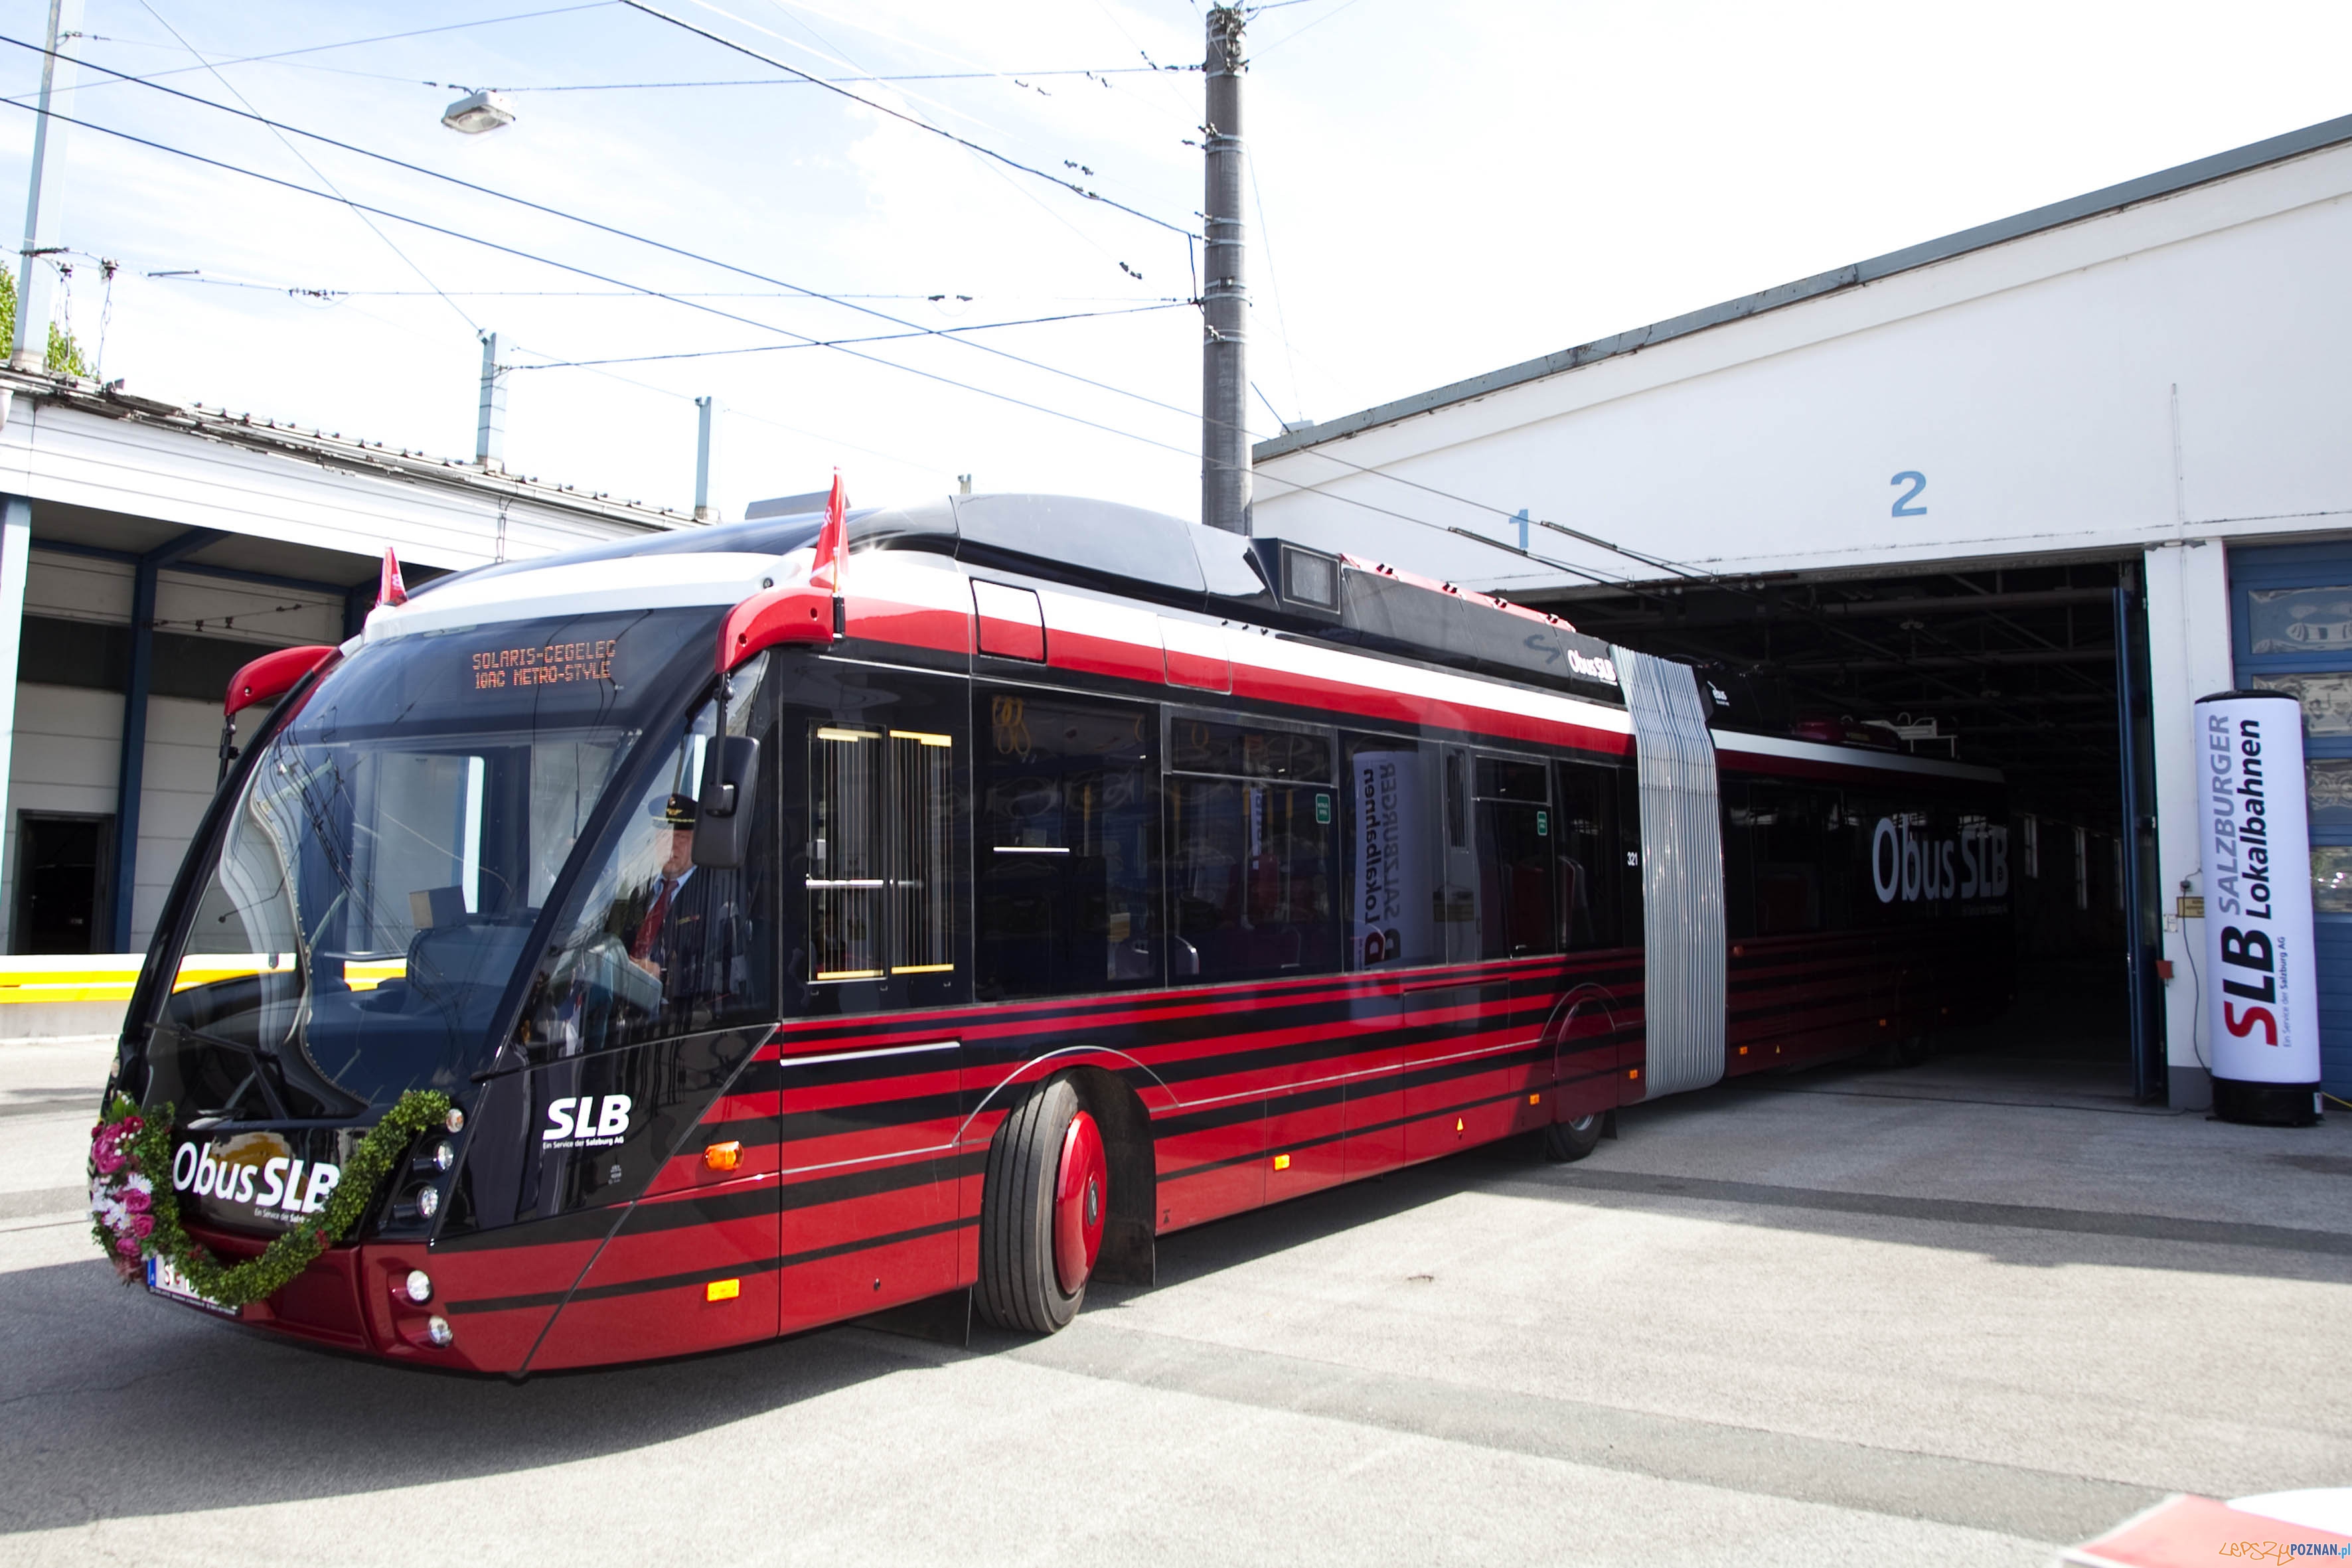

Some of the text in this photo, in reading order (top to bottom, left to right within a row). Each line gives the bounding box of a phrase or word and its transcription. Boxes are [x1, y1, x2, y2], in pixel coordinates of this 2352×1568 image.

[1891, 471, 1927, 518] 2
[1509, 509, 1528, 548] 1
[473, 640, 616, 670] SOLARIS-CEGELEC
[514, 661, 611, 685] METRO-STYLE
[2208, 714, 2241, 915] SALZBURGER
[2236, 719, 2272, 919] Lokalbahnen
[1627, 852, 1638, 866] 321
[1873, 814, 2009, 903] Obus SLB
[2277, 936, 2286, 949] AG
[2221, 926, 2278, 1046] SLB
[2278, 952, 2288, 990] Salzburg
[2282, 1007, 2290, 1033] Service
[543, 1095, 631, 1140] SLB
[586, 1137, 613, 1146] Salzburg
[173, 1142, 340, 1213] Obus SLB
